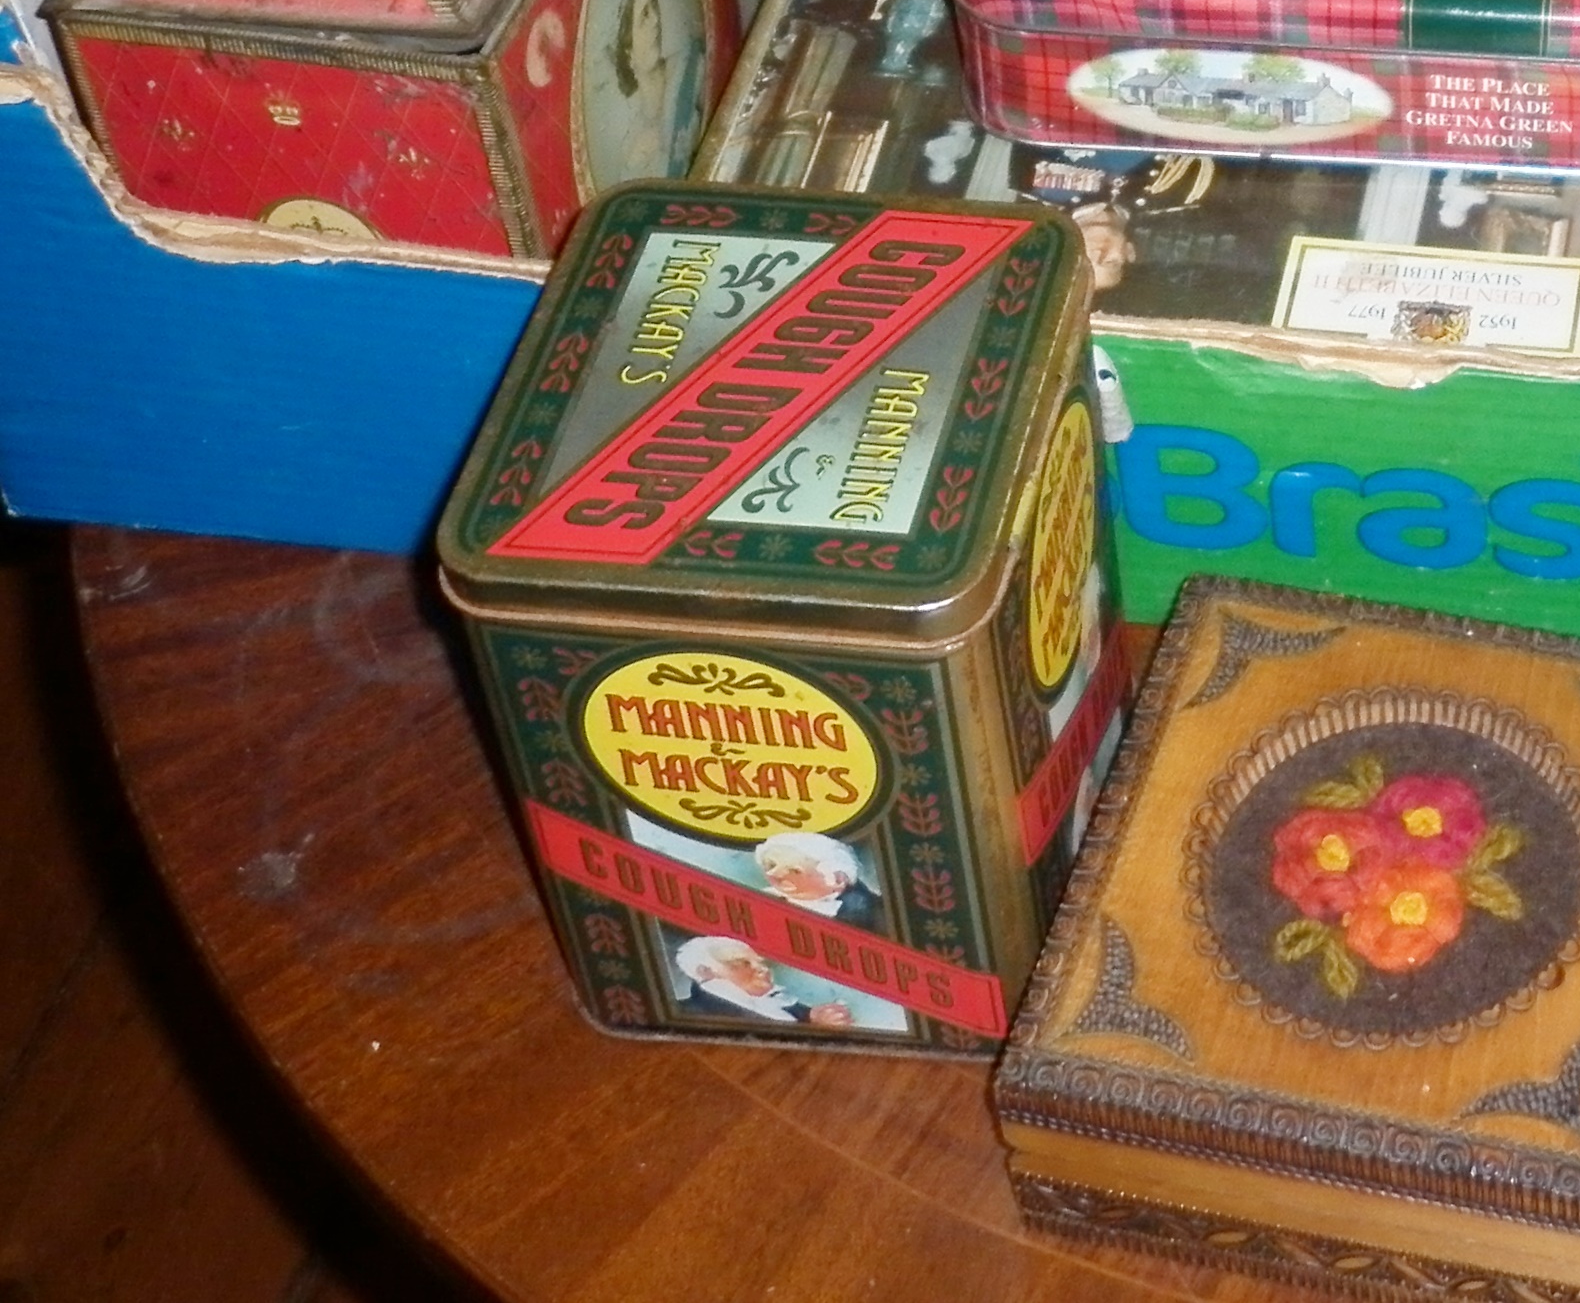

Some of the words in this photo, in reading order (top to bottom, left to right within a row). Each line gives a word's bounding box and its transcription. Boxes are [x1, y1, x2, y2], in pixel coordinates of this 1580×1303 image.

[1429, 73, 1475, 92] THE
[1481, 76, 1551, 97] PLACE
[1424, 91, 1483, 110] THAT
[1488, 95, 1555, 116] MADE
[1404, 108, 1493, 130] GRETNA
[1499, 115, 1574, 134] GREEN
[1446, 129, 1533, 150] FAMOUS
[1360, 262, 1447, 282] JUBILEE
[1451, 270, 1522, 286] SILVER
[1333, 276, 1470, 300] ELIZABETH
[1477, 288, 1560, 307] QUEEN
[620, 238, 723, 386] MACKAY'S
[733, 240, 962, 379] COUGH
[1347, 304, 1386, 320] 1977
[1479, 314, 1516, 330] 1952
[565, 381, 775, 531] DROPS
[829, 367, 931, 528] MANNING
[605, 693, 848, 752] MANNING
[620, 747, 862, 808] MACKAY'S
[578, 836, 759, 940] COUGH
[788, 915, 957, 1008] DROPS
